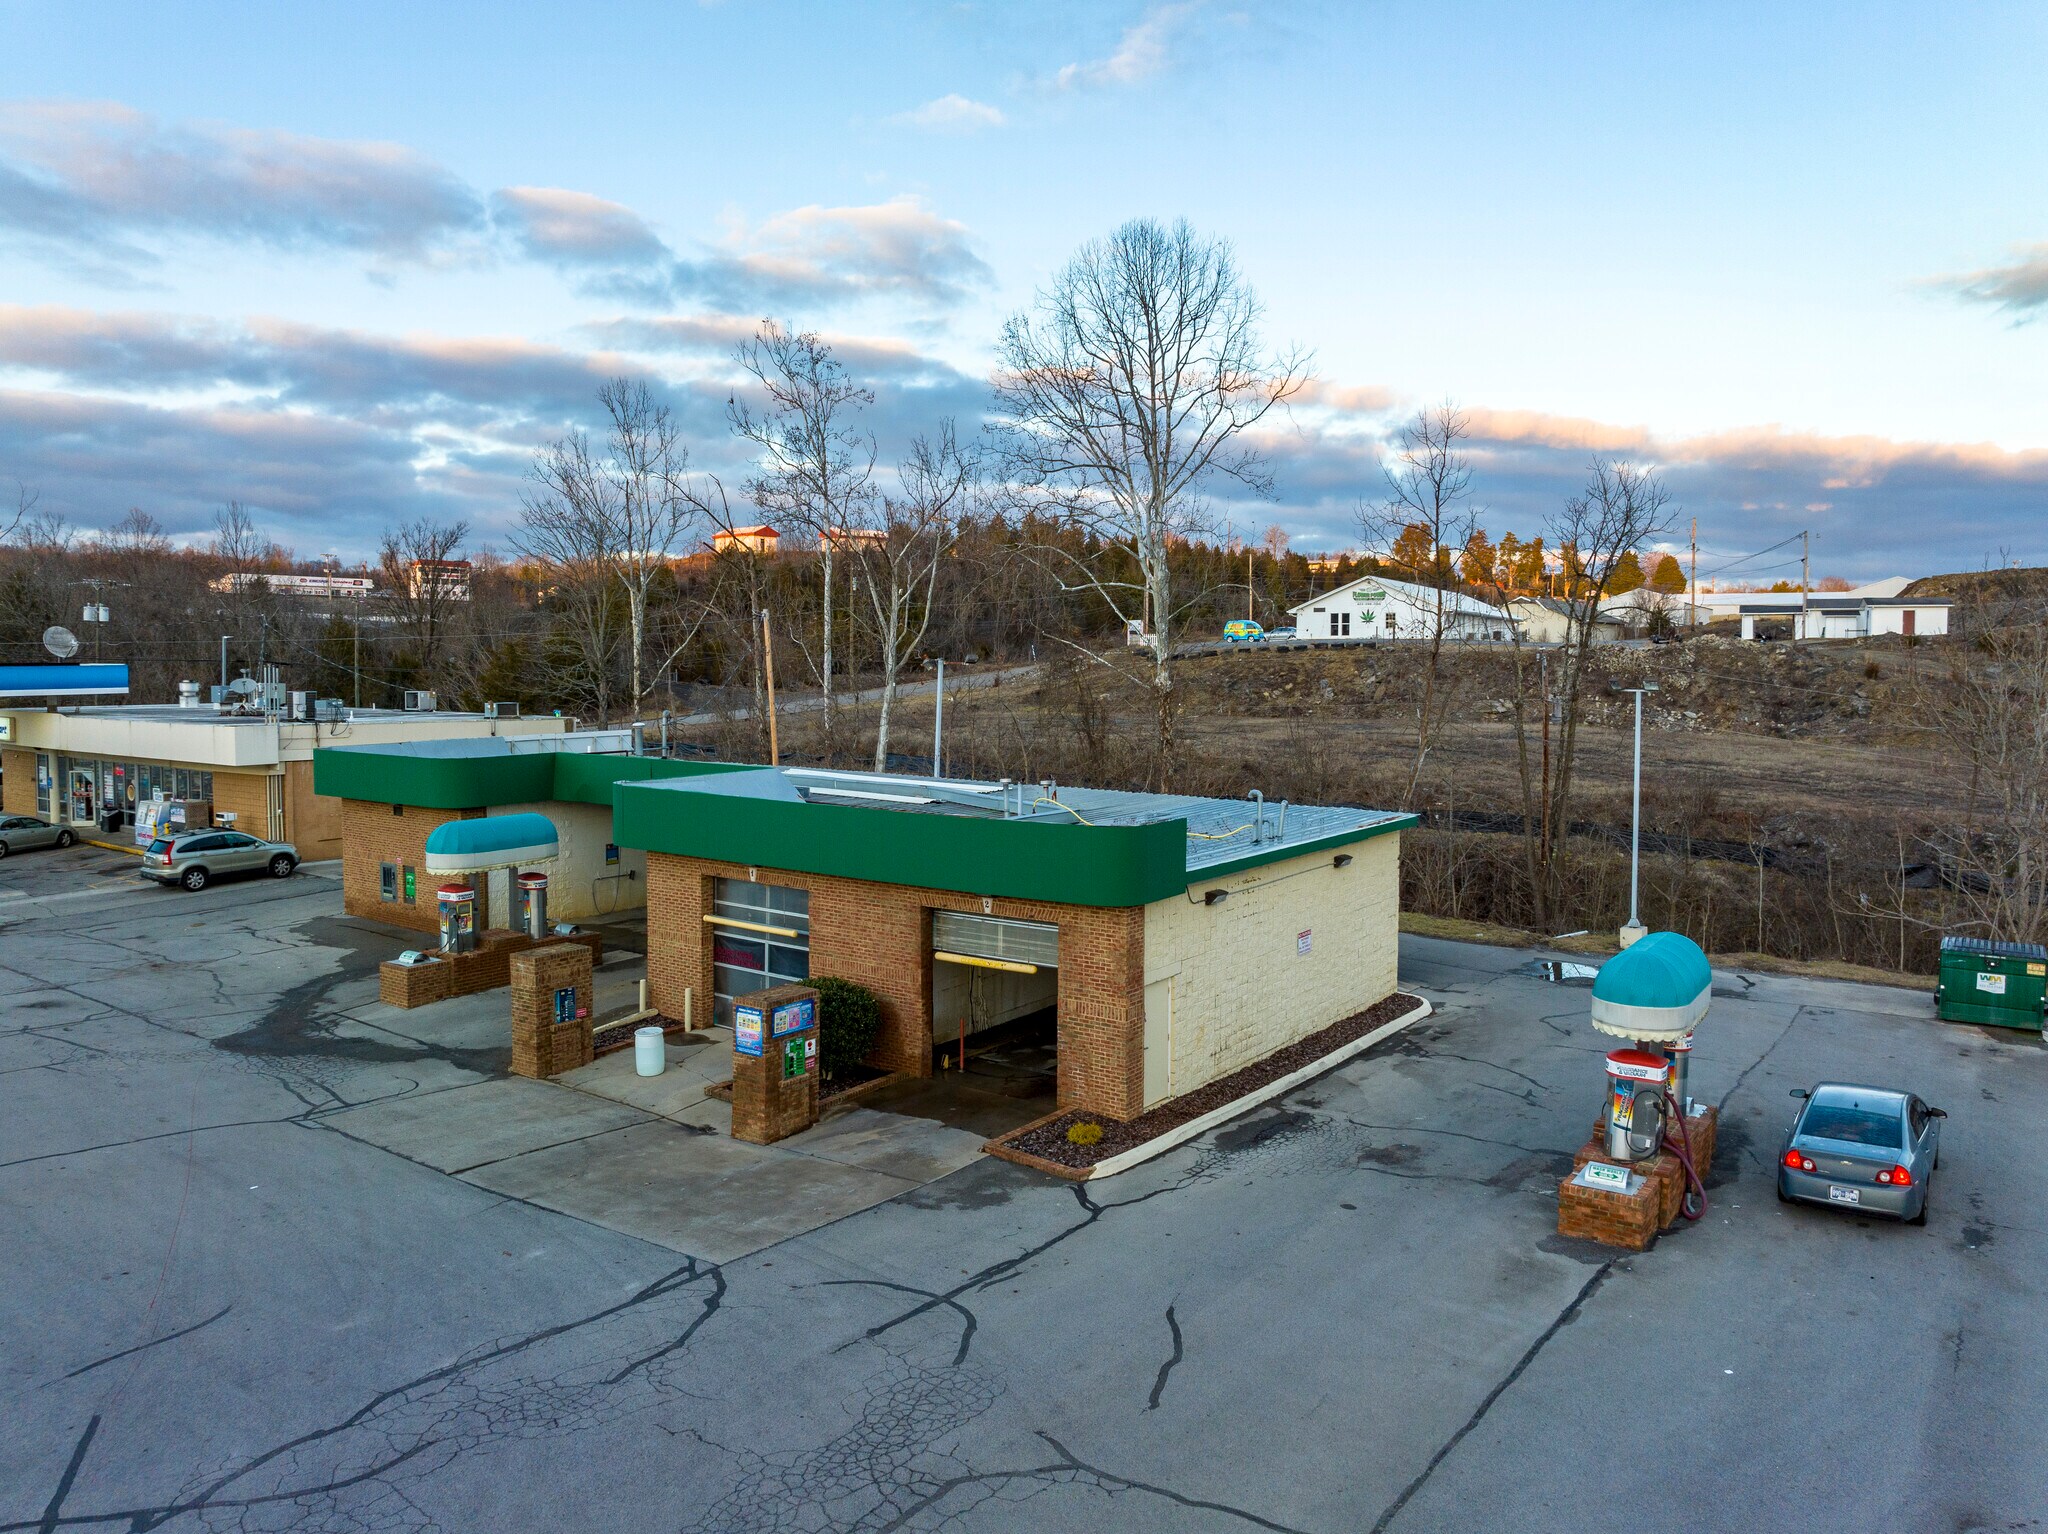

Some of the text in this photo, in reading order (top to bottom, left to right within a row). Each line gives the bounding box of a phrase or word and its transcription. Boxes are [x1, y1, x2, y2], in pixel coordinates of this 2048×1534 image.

[750, 869, 754, 877] 1
[984, 900, 990, 908] 2
[1979, 974, 2002, 982] WM
